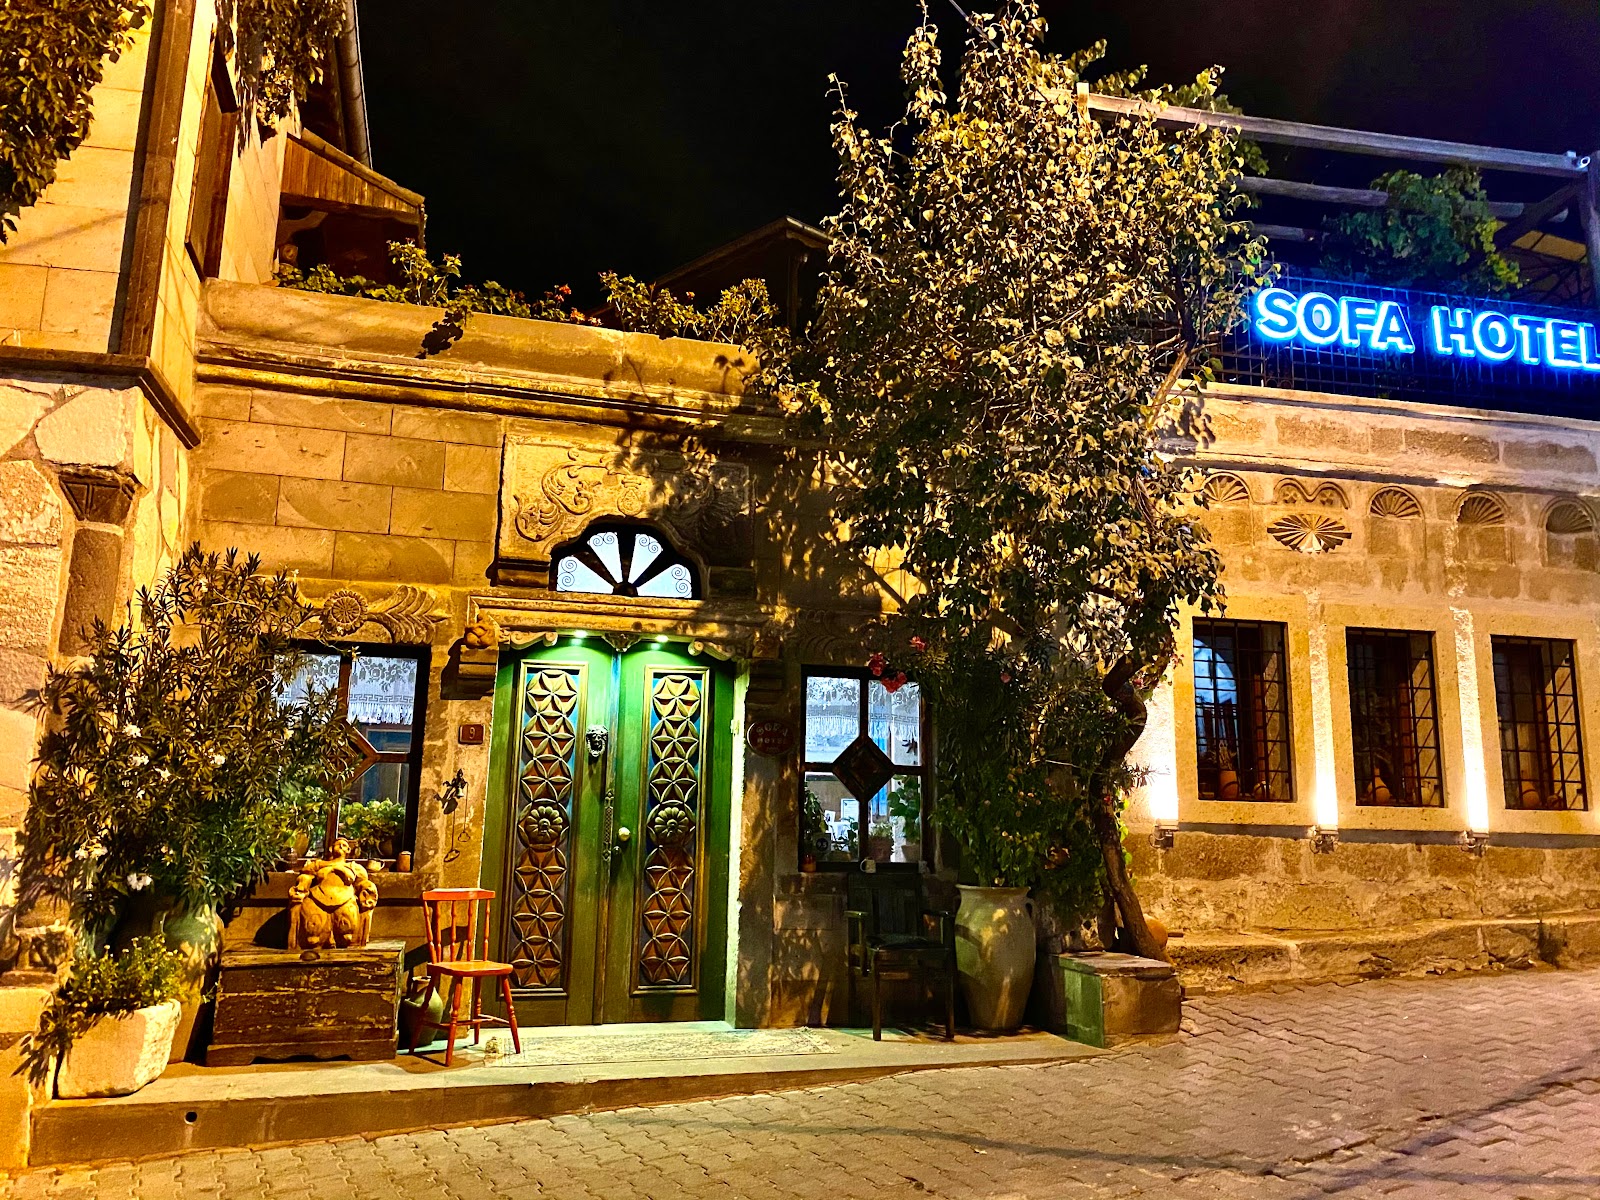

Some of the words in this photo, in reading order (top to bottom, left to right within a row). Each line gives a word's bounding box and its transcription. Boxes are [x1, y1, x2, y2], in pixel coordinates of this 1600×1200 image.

[1256, 287, 1416, 354] SOFA
[1431, 305, 1600, 370] HOTEL
[469, 726, 476, 740] 9
